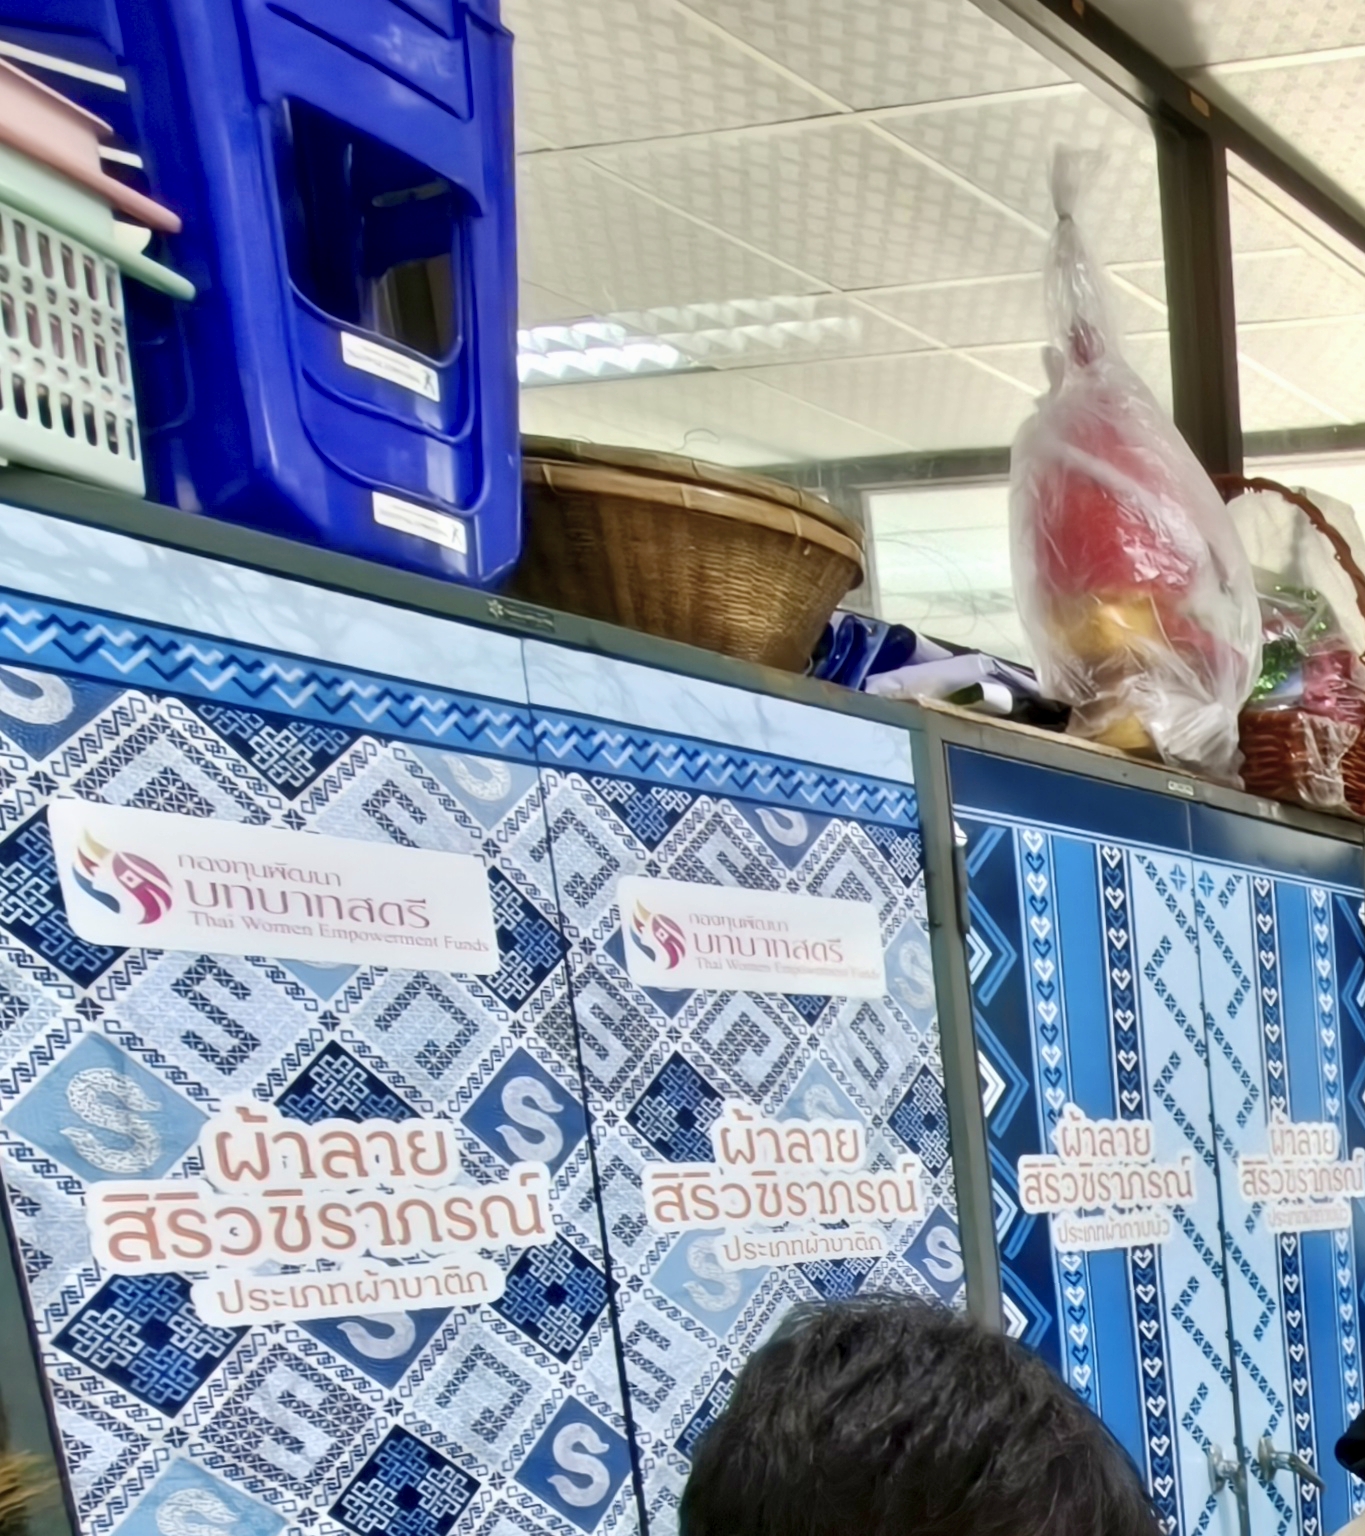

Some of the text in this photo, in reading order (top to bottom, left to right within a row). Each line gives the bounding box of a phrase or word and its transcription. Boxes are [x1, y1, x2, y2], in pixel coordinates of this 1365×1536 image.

[177, 853, 342, 888] กองทุนพัฒนา
[184, 878, 431, 930] บทบาทสตรี
[188, 909, 491, 954] Thai Women Empowerment Funds
[692, 932, 844, 964] บทบาทสตรี
[214, 1104, 450, 1183] ผ้าลาย
[719, 1107, 861, 1166] ผ้าลาย
[1060, 1112, 1151, 1158] ผ้าลาย
[1270, 1114, 1338, 1157] ผ้าลาย
